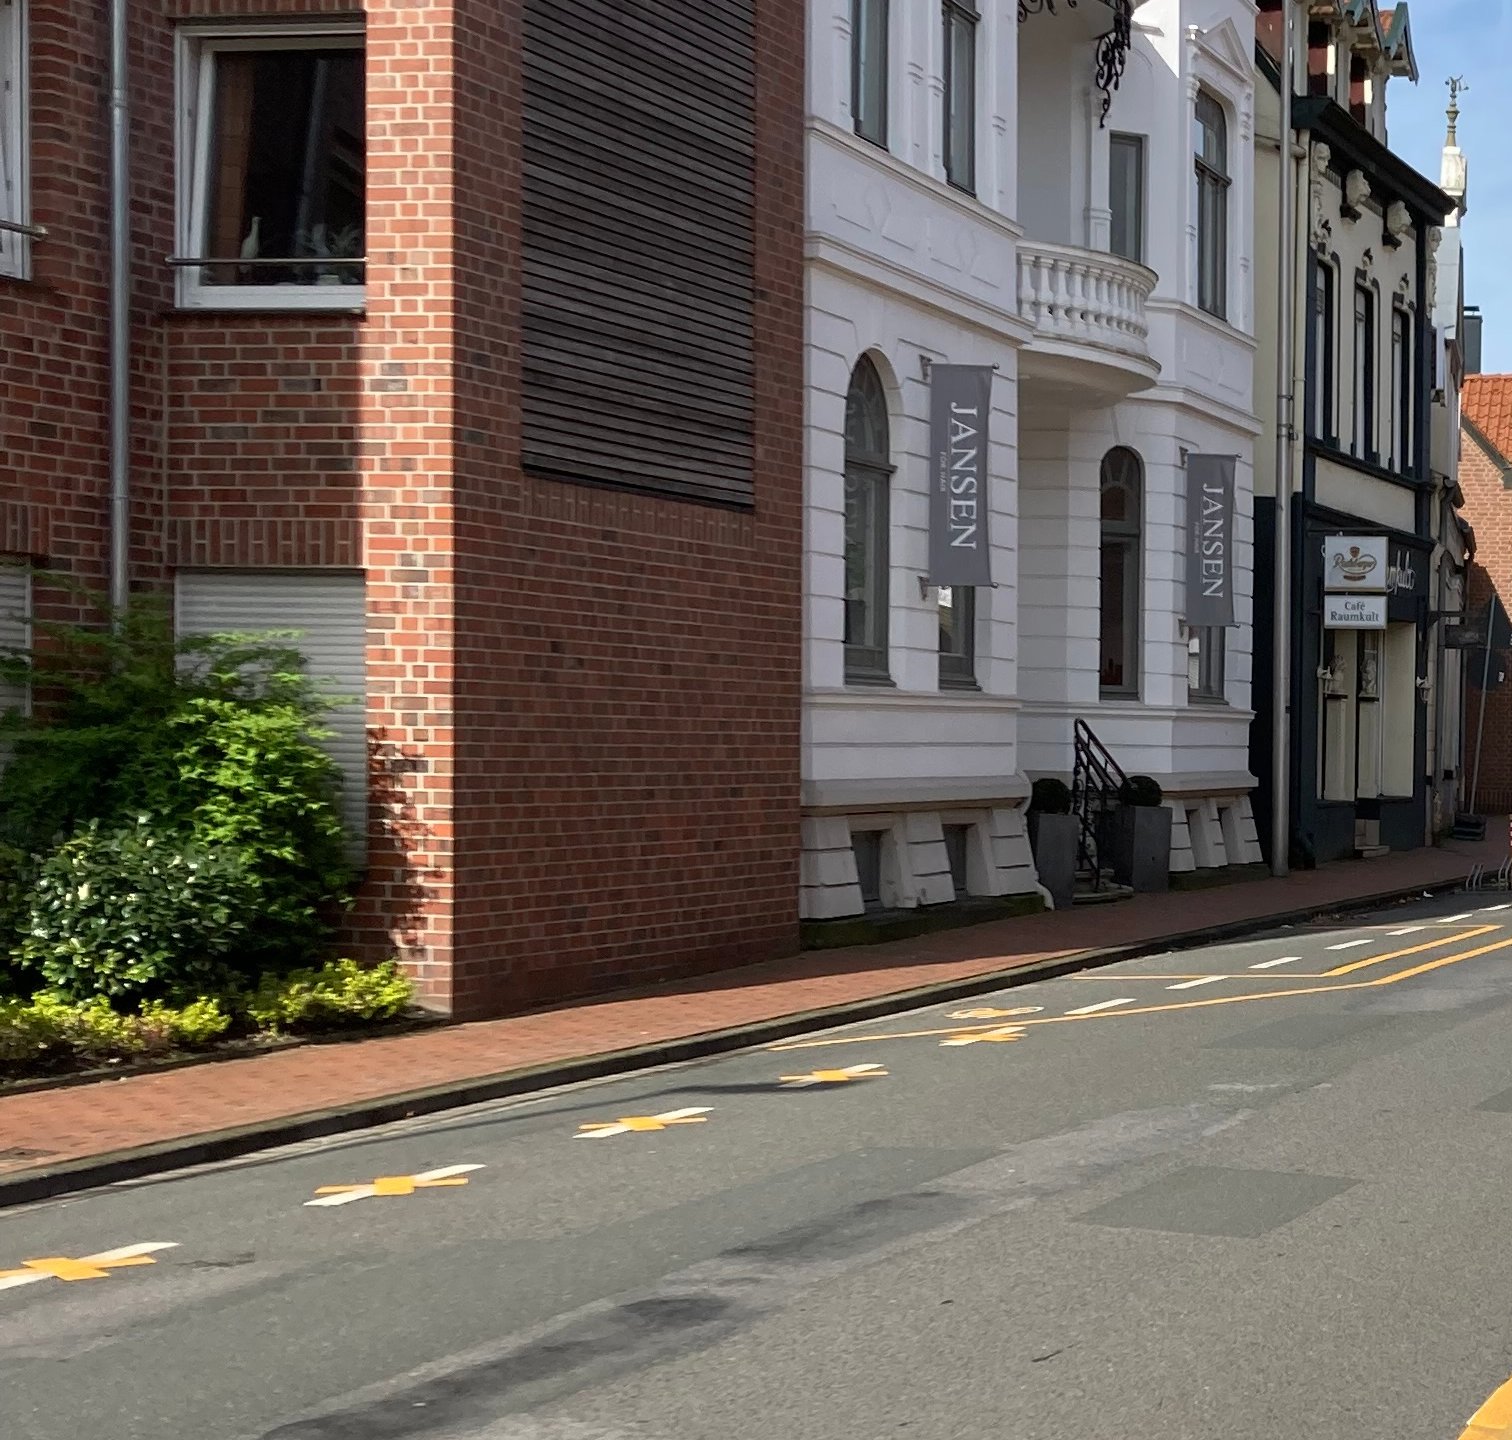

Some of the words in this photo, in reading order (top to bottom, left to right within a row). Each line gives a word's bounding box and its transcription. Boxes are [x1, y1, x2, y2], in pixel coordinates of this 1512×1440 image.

[950, 401, 978, 550] JANSEN
[1202, 483, 1224, 598] JANSEN
[1330, 611, 1379, 622] Raumkult
[1344, 601, 1366, 611] Café
